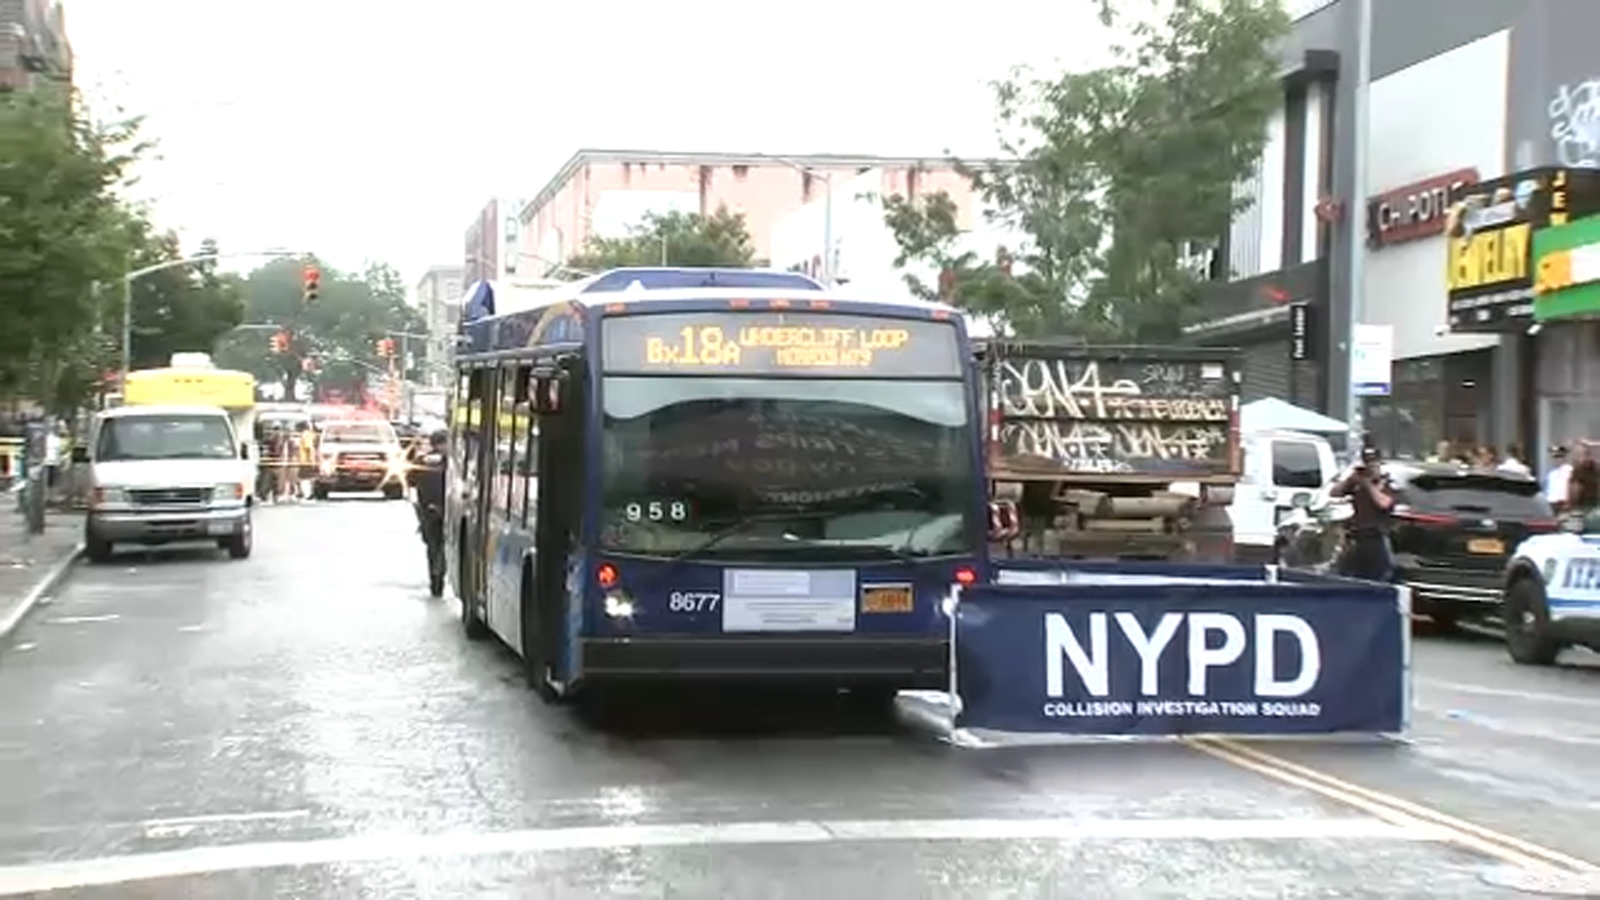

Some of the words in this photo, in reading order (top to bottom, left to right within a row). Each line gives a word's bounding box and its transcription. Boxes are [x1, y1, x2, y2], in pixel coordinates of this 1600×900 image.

[859, 329, 908, 349] LOOP
[670, 592, 720, 611] 8677
[1045, 612, 1321, 697] NYPD
[1044, 701, 1132, 716] COLLISION
[1138, 701, 1257, 716] INVESTIGATION
[1261, 703, 1321, 717] SQUAD
